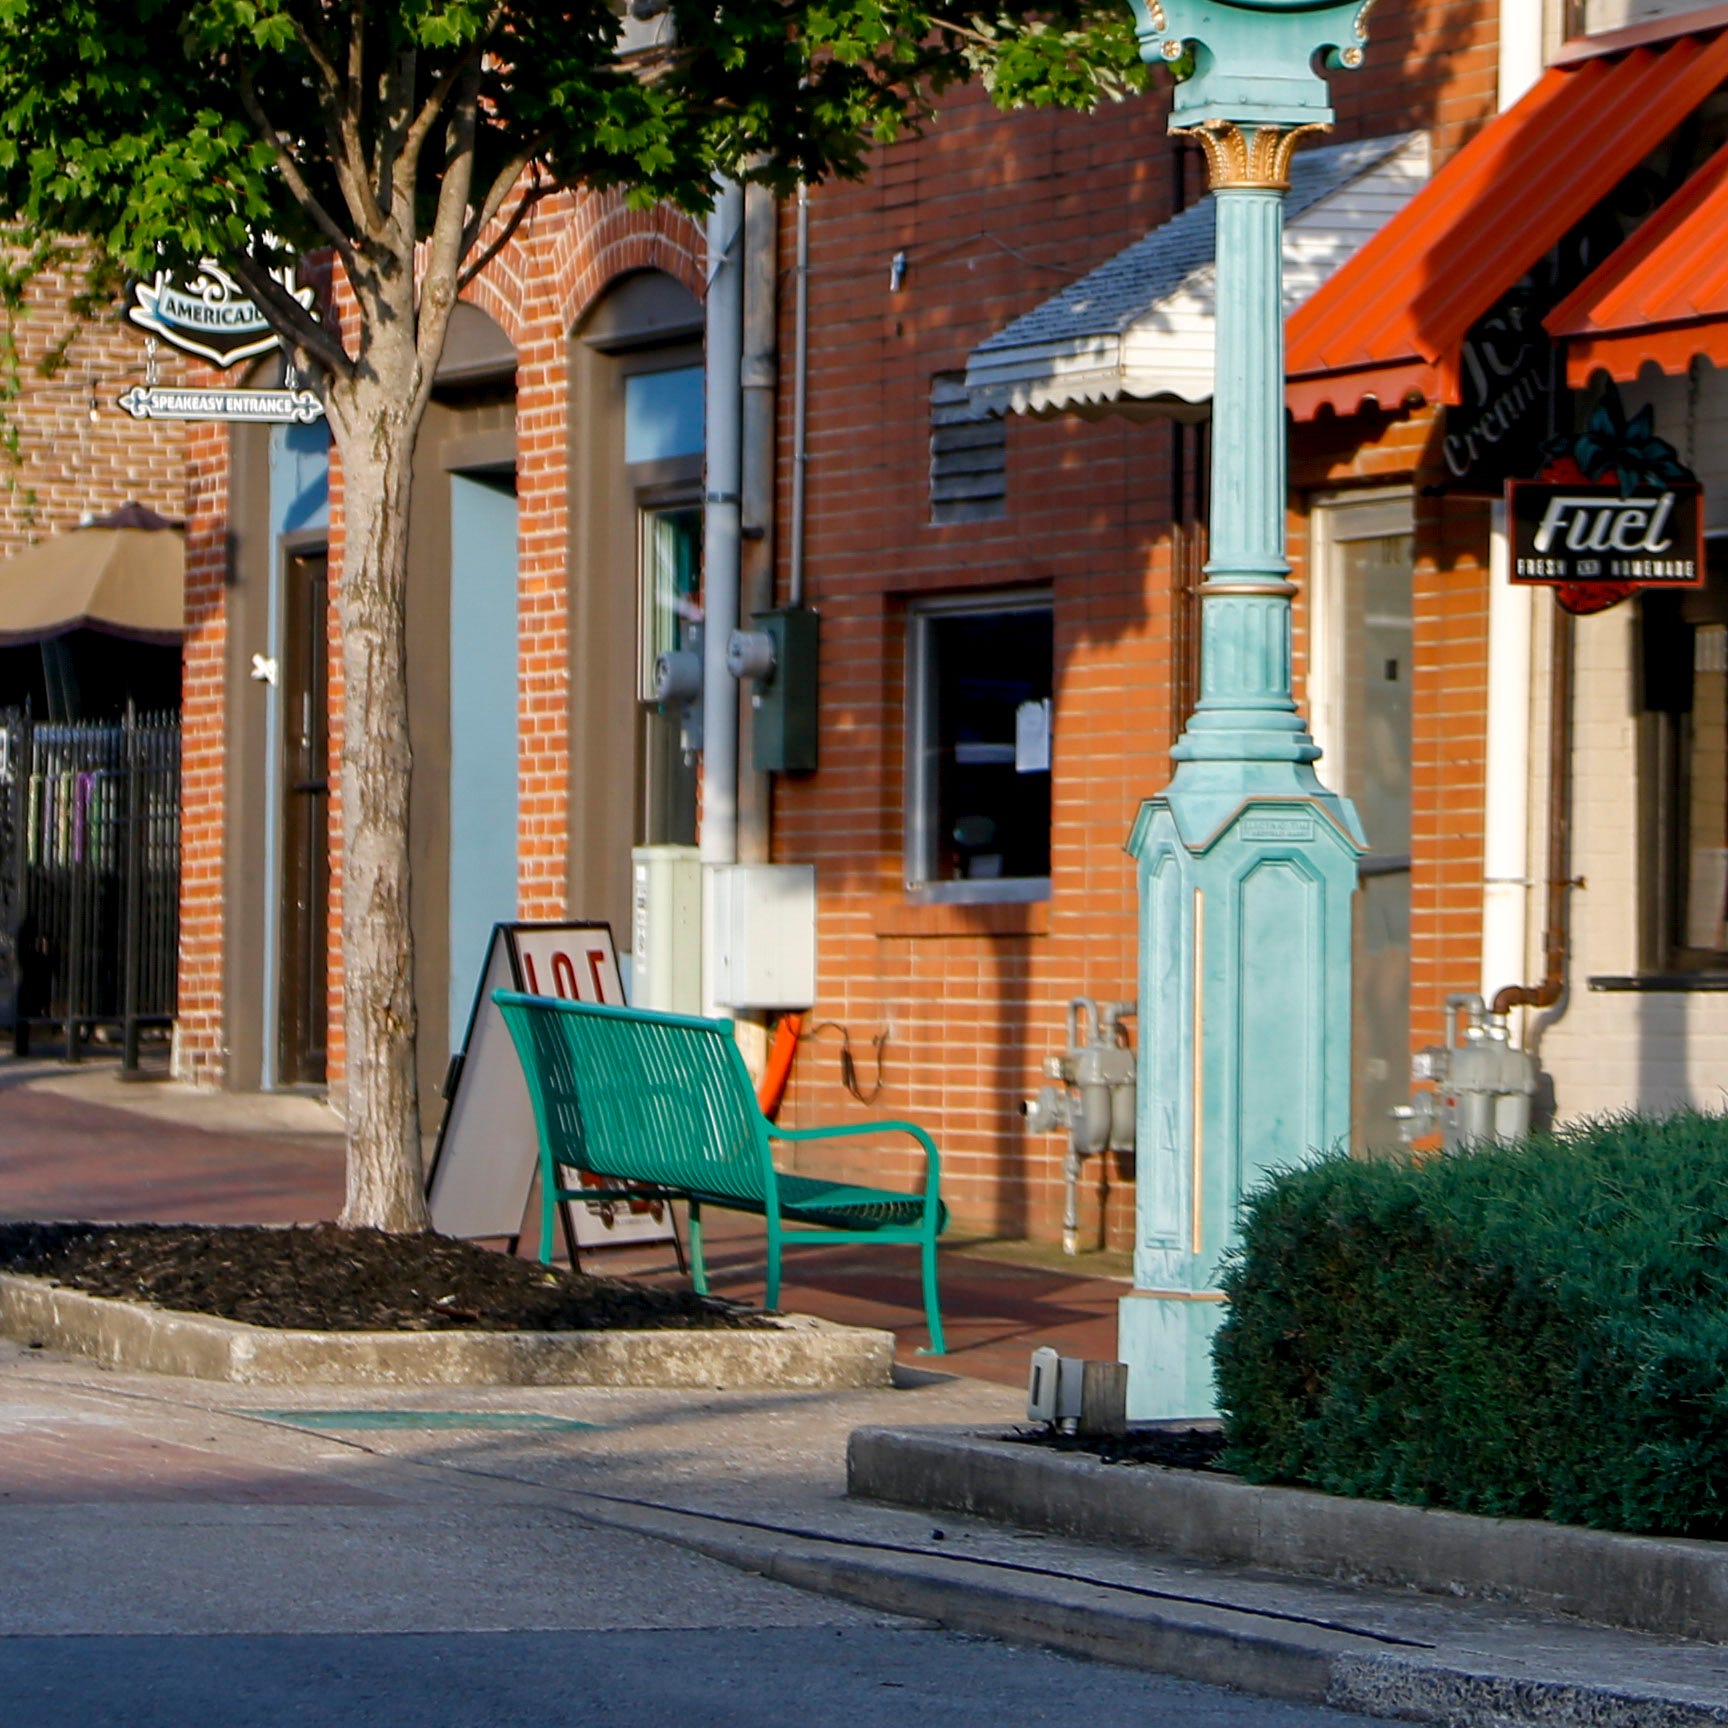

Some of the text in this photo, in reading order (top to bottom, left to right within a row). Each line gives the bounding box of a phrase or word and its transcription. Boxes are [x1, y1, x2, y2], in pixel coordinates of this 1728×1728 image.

[152, 395, 292, 413] SPEAKEASY ENTRANCE
[1534, 491, 1675, 553] Fuel
[1517, 558, 1567, 577] FRESH
